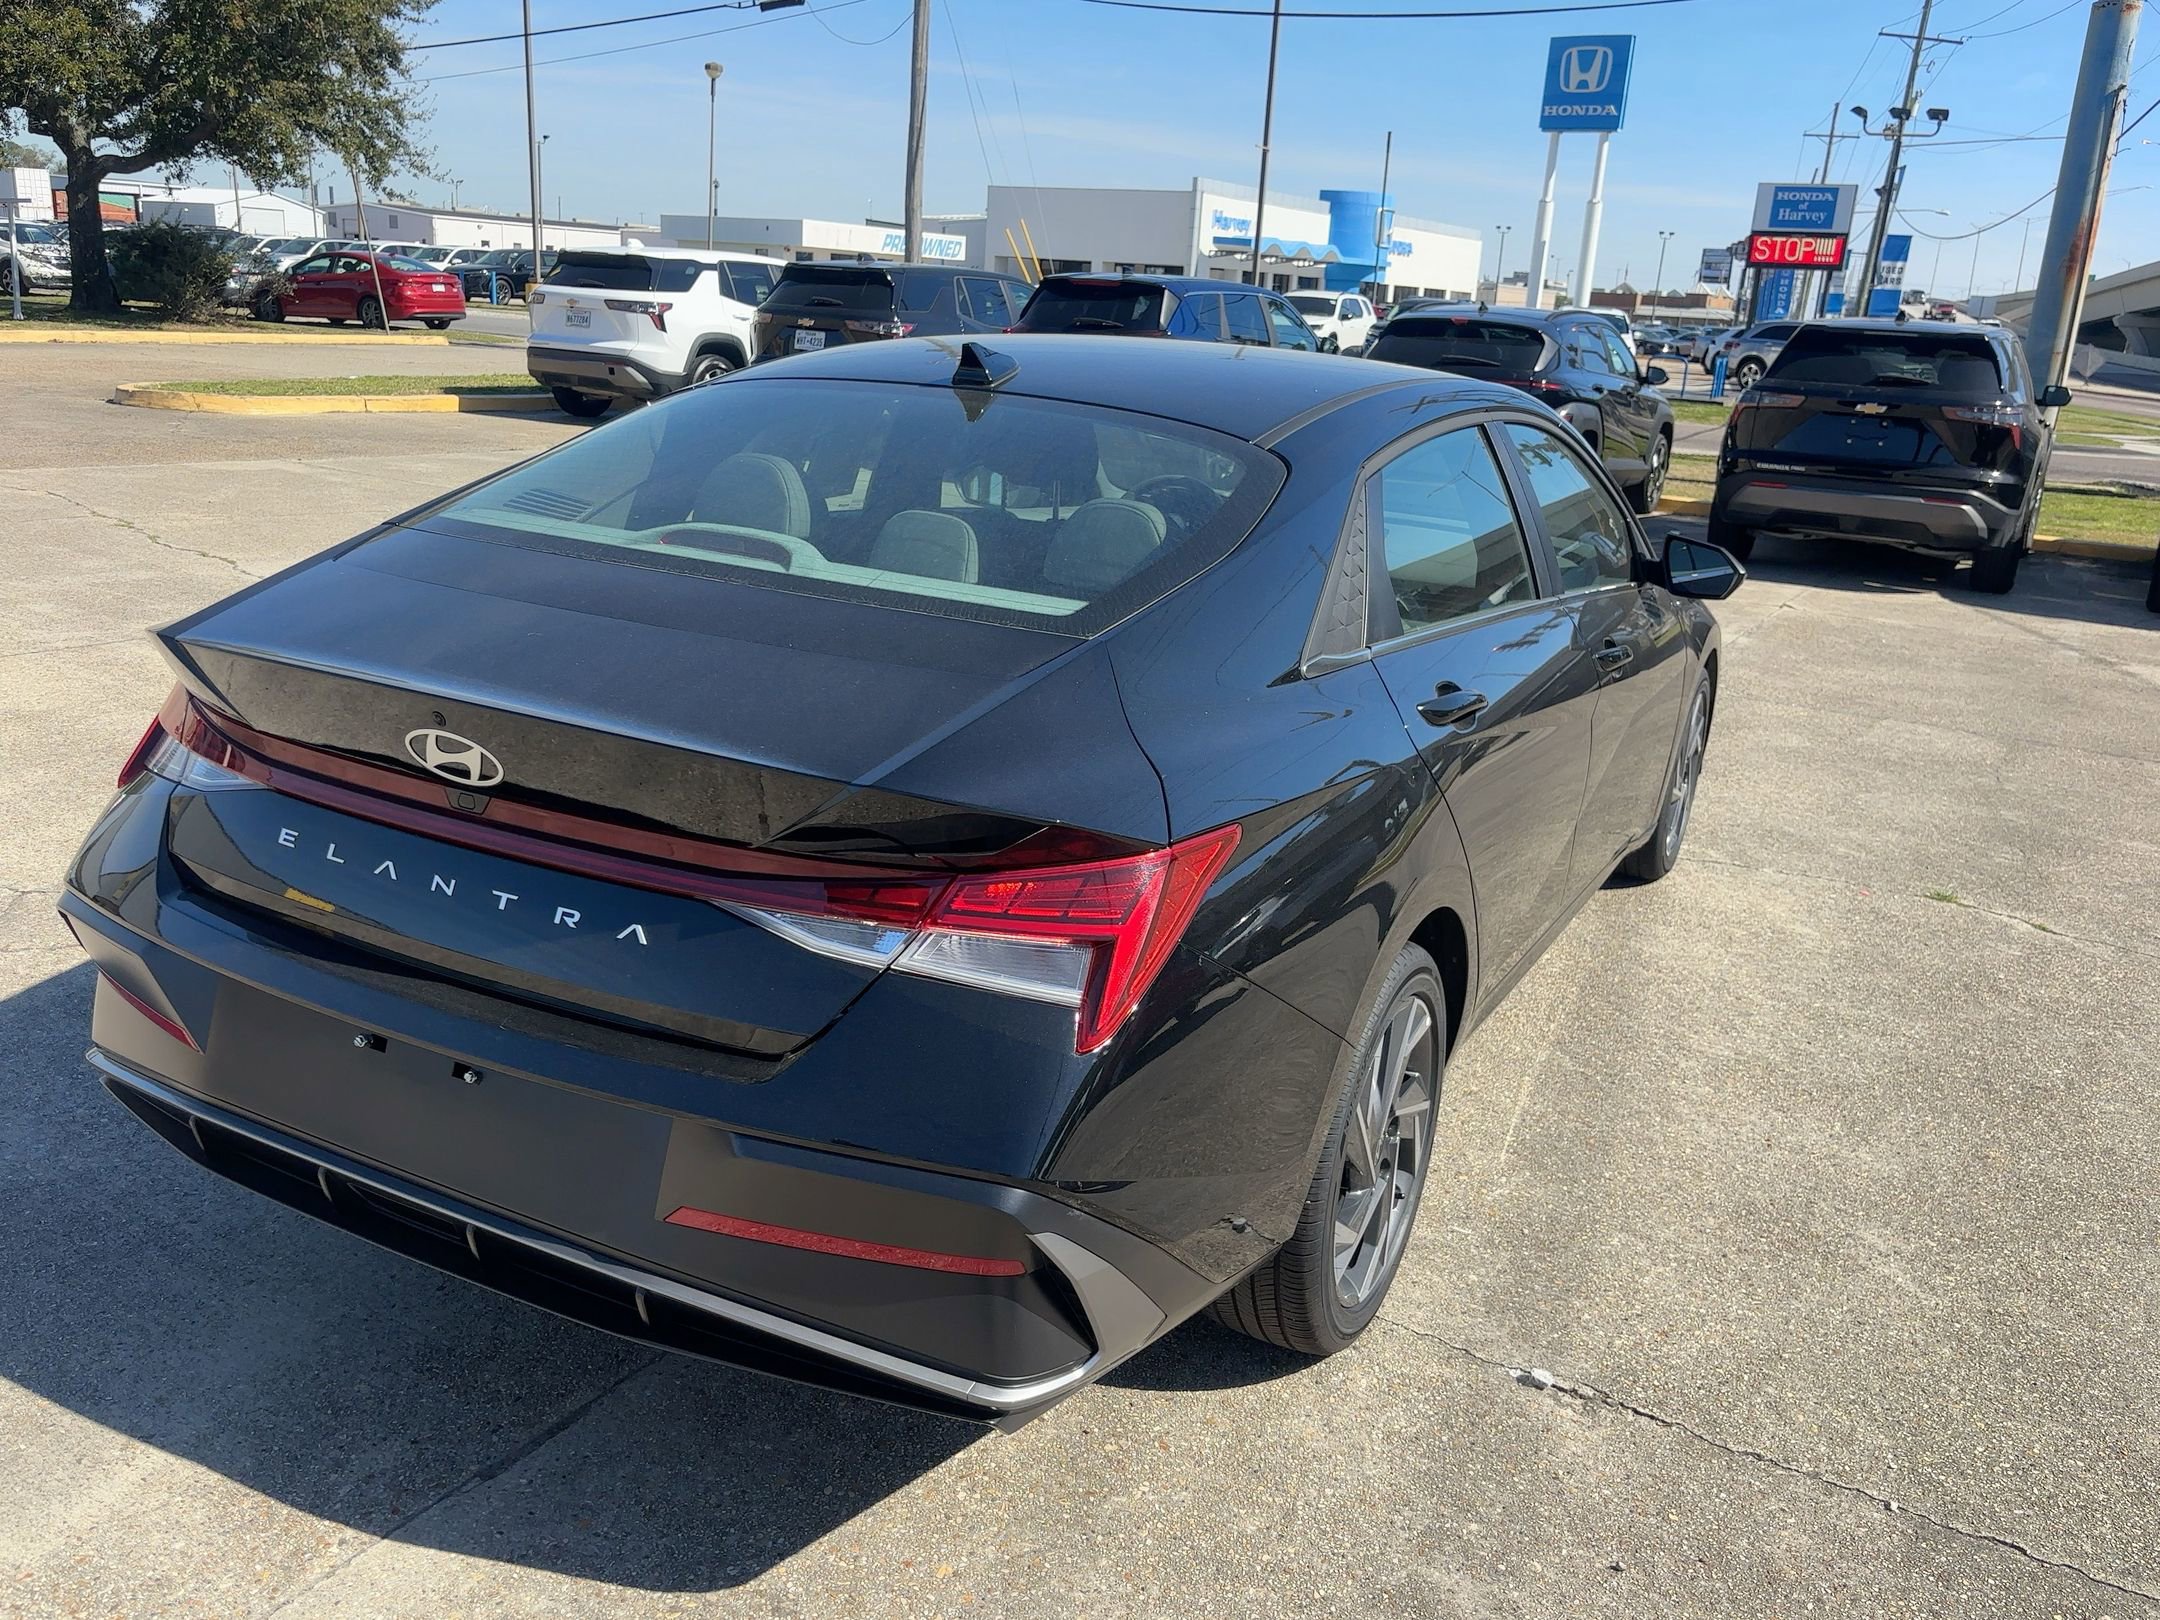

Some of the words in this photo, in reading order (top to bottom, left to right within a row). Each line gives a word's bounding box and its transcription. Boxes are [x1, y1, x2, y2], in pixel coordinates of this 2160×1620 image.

[1543, 104, 1618, 117] HONDA
[1776, 191, 1834, 201] HONDA
[1798, 202, 1809, 210] of
[1777, 207, 1827, 224] Harvey
[277, 826, 648, 946] ELANTRA
